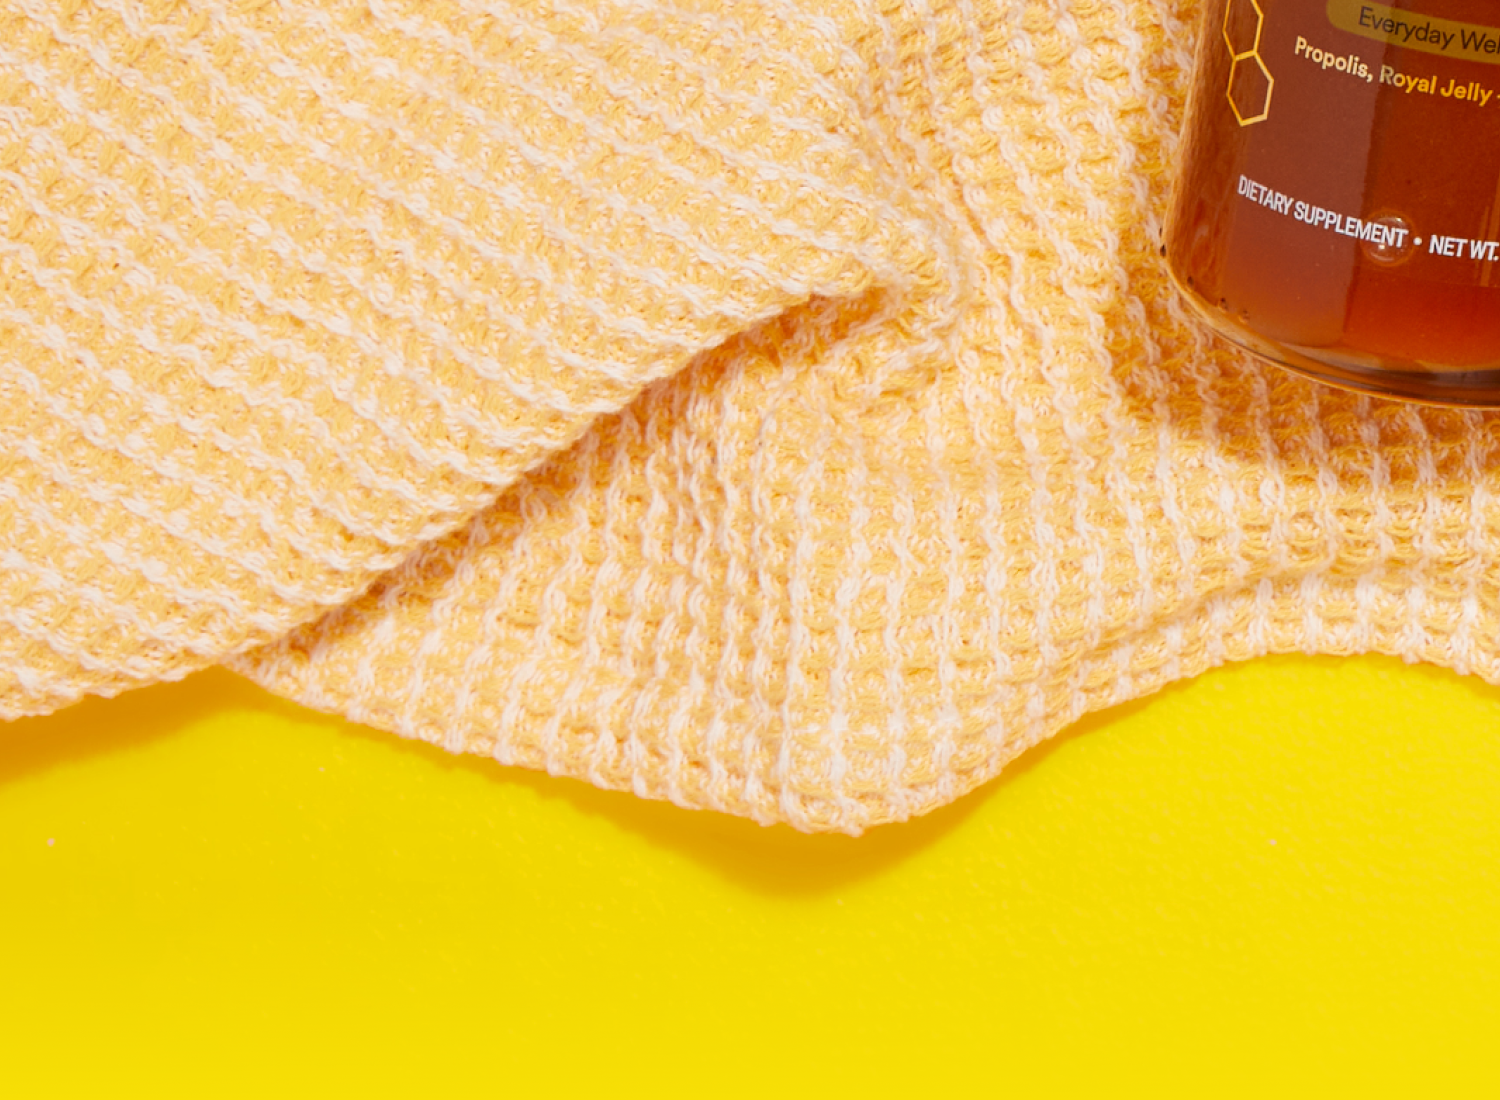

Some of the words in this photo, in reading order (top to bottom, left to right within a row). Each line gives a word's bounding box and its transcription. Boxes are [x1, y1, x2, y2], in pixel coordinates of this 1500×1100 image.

[1358, 5, 1455, 49] Everyday
[1294, 35, 1373, 83] Propolis,
[1379, 64, 1437, 94] Royal
[1440, 76, 1492, 107] Jelly
[1238, 174, 1295, 215] DIETARY
[1293, 202, 1409, 248] SUPPLEMENT
[1429, 234, 1467, 258] NET
[1470, 240, 1499, 261] WT.
